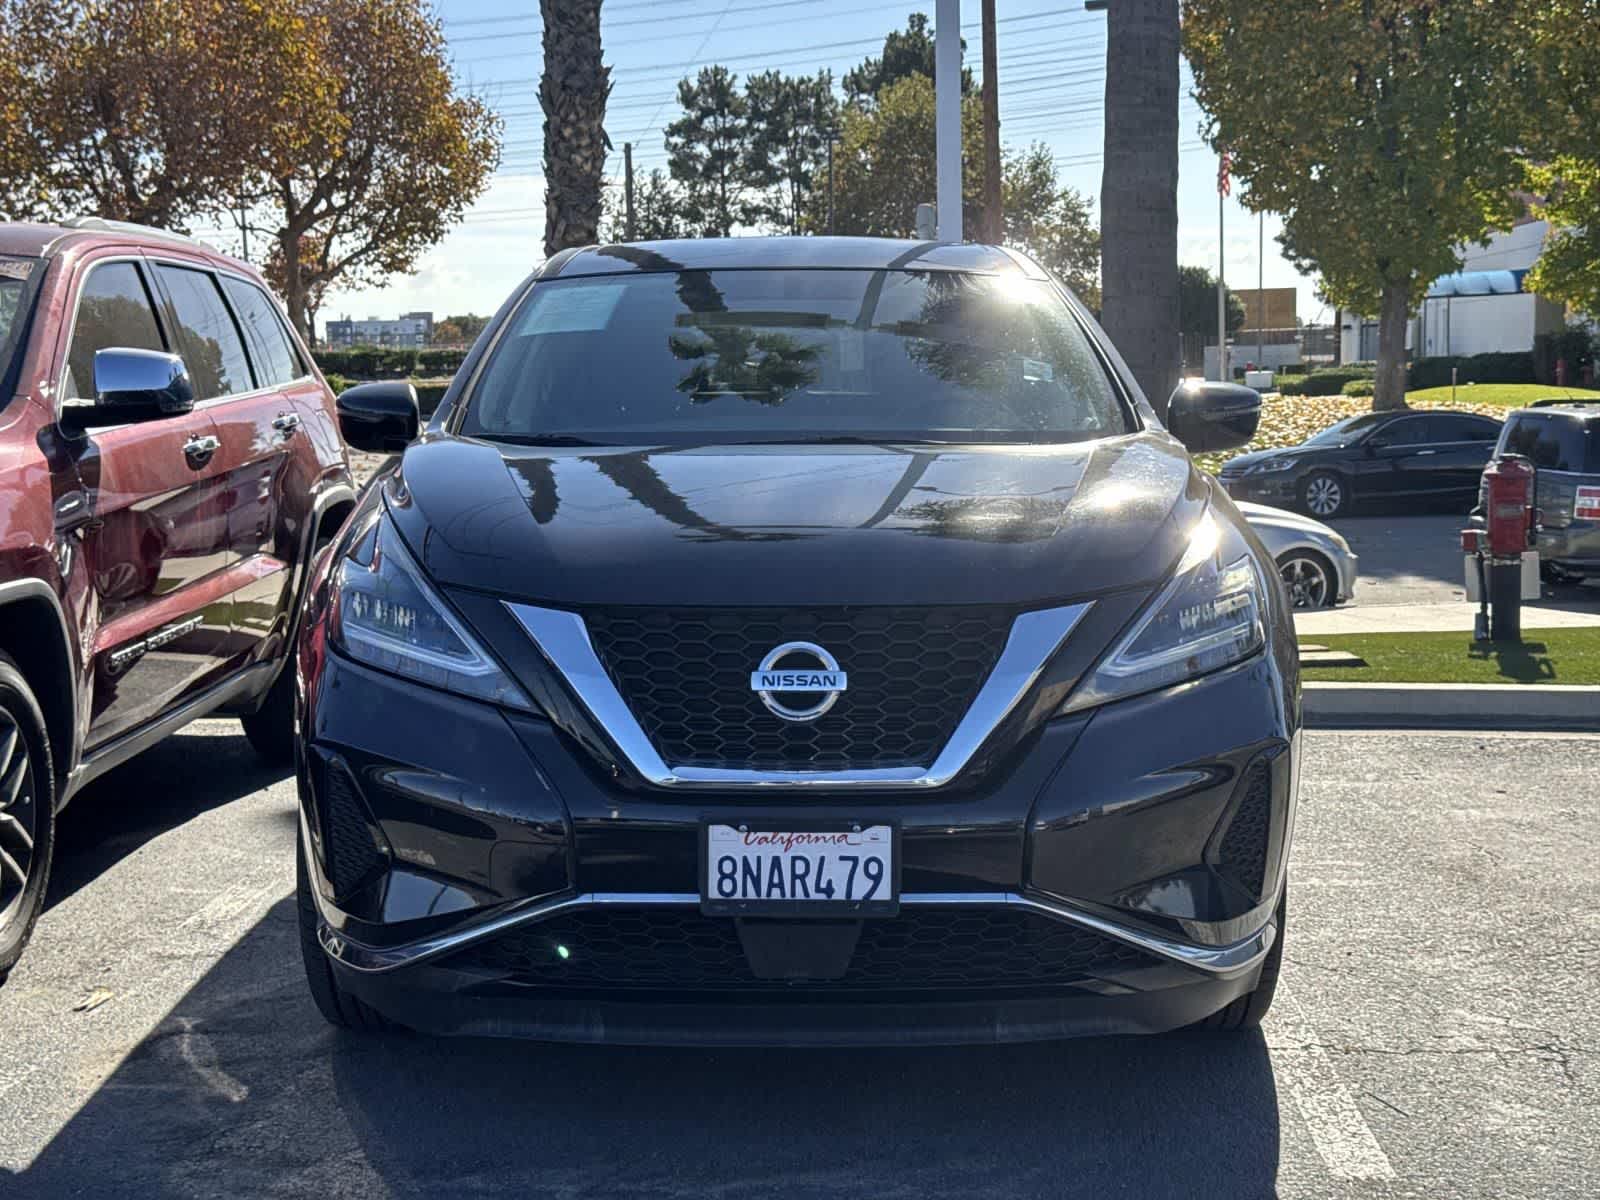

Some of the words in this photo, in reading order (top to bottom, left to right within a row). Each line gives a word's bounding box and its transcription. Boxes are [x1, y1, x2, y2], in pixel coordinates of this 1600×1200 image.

[761, 675, 837, 687] NISSAN
[743, 832, 862, 852] California
[717, 855, 884, 900] 8NAR479
